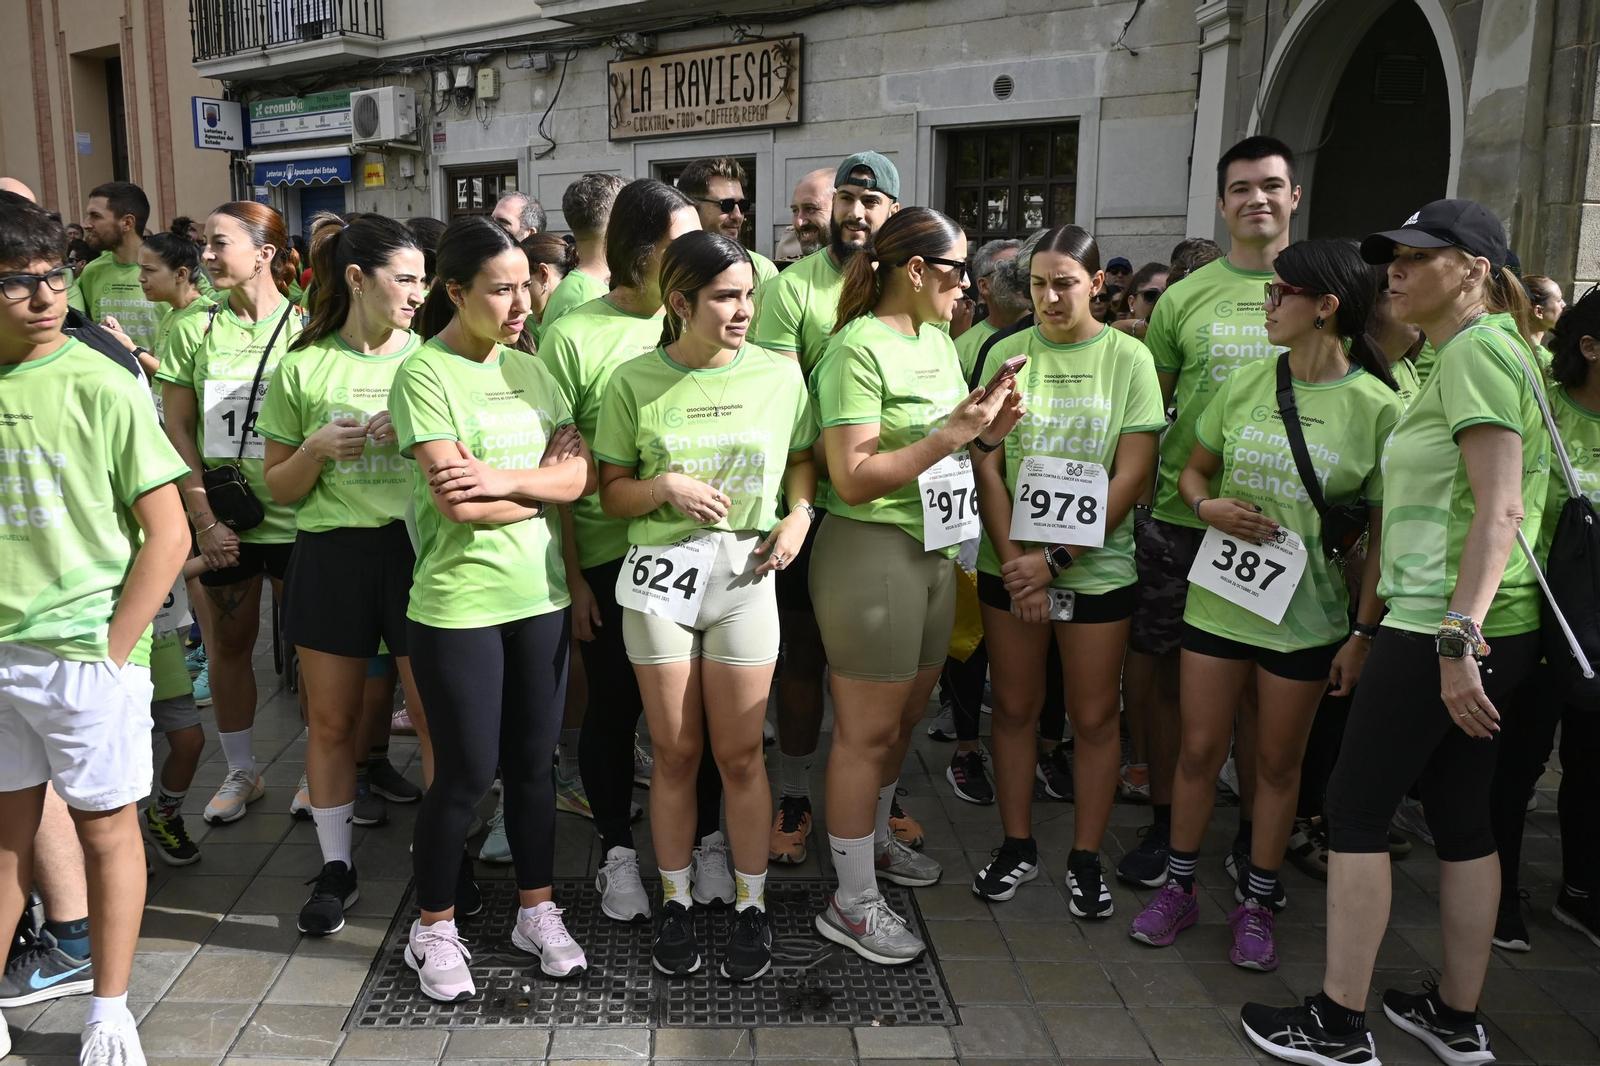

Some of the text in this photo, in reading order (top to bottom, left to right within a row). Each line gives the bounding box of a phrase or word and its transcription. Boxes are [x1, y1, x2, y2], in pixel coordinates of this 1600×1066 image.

[630, 49, 772, 113] LA TRAVIESA
[633, 114, 670, 132] COCKTAIL
[677, 111, 695, 129] FOOD
[294, 168, 314, 176] Apuestas
[322, 166, 337, 174] Estado
[101, 297, 155, 309] En marcha
[1212, 322, 1237, 336] En
[1022, 391, 1113, 411] En marcha
[1019, 412, 1109, 433] contra el
[483, 430, 541, 450] contra
[664, 426, 773, 452] En marcha
[1021, 429, 1107, 456] cáncer
[1241, 425, 1340, 465] En mcha
[486, 449, 544, 470] cánc
[668, 452, 747, 474] contra
[34, 474, 63, 499] el
[346, 478, 371, 486] MARCHA
[1211, 539, 1287, 591] 387
